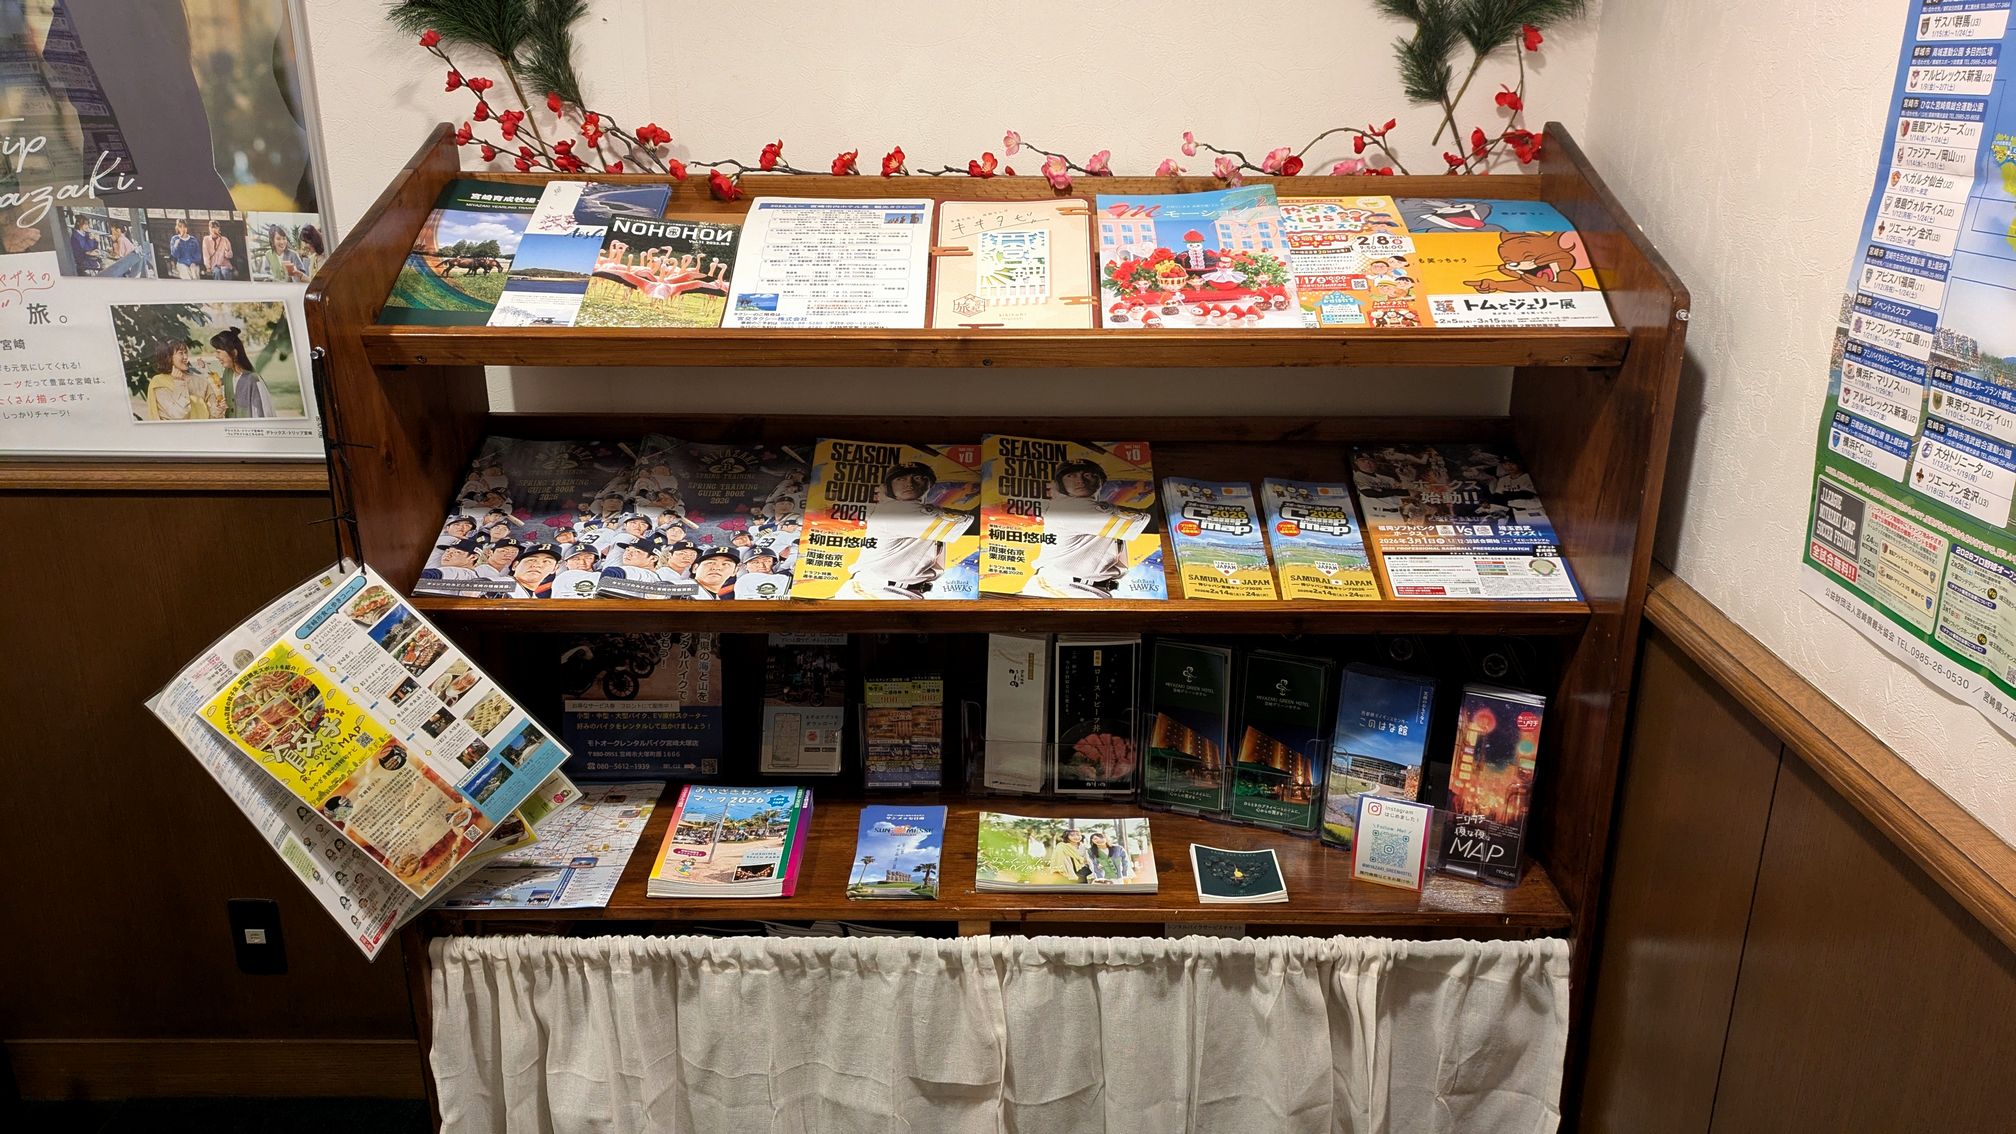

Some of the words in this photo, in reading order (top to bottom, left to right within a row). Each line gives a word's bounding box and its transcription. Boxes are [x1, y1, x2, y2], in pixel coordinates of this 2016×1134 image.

[1463, 297, 1576, 311] トムとジェリー展
[27, 303, 68, 325] 旅。
[1945, 396, 2012, 429] 東京ヴェルディ(J1)
[1926, 418, 1945, 433] 宮崎市
[831, 442, 901, 465] SEASON
[999, 438, 1067, 461] SEASON
[1005, 458, 1057, 480] START
[1934, 447, 1993, 479] 大分トリニータ(J2)
[834, 462, 889, 483] START
[825, 481, 879, 503] GUIDE
[998, 476, 1052, 499] GUIDE
[1413, 480, 1481, 490] ホークス
[1928, 473, 1989, 508] ツエーゲン金沢(J3)
[1421, 492, 1480, 505] 始動!!
[831, 504, 867, 521] 2026
[1007, 499, 1042, 517] 2026
[1211, 510, 1248, 519] 2026
[1310, 510, 1345, 519] 2026
[1200, 520, 1252, 535] map
[1299, 520, 1351, 535] map
[1456, 525, 1473, 536] VS
[808, 534, 878, 549] 柳田悠岐
[989, 530, 1057, 545] 柳田悠岐
[1811, 544, 1855, 582] 全試合無料!!
[1188, 574, 1228, 584] SAMURAI
[1290, 574, 1331, 585] SAMURAI
[943, 584, 972, 593] HAWKS
[1129, 583, 1159, 592] HAWKS
[1092, 668, 1102, 732] ローストビーフ丼
[1359, 716, 1410, 736] このはな館
[337, 725, 362, 749] MAP
[730, 795, 765, 806] 2026
[1384, 812, 1420, 823] はじめました!
[1385, 805, 1414, 815] Instagram
[1449, 837, 1505, 862] MAP
